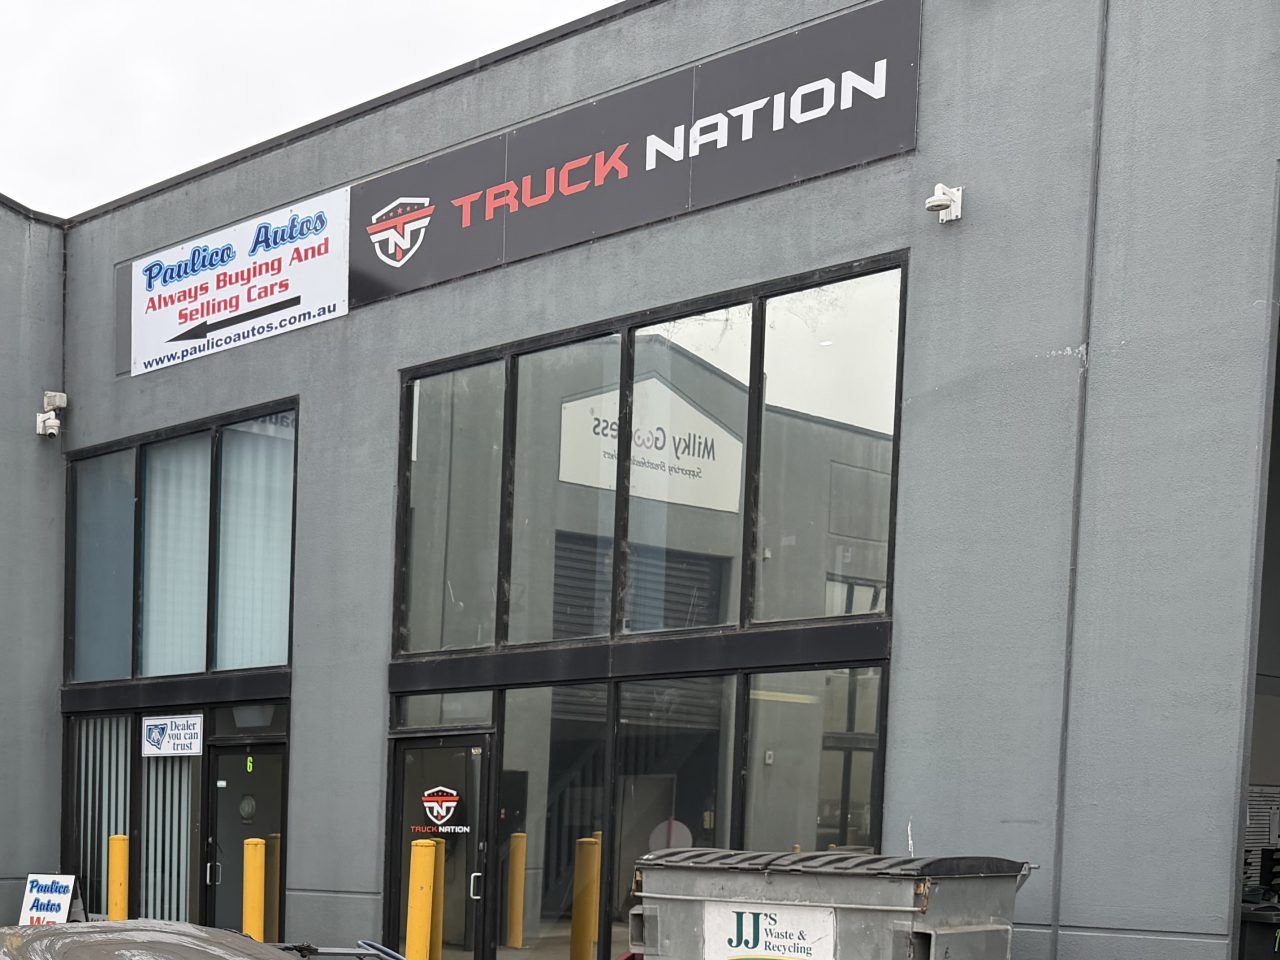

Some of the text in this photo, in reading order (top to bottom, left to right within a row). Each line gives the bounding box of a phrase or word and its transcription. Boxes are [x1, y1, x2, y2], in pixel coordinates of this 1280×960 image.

[451, 58, 887, 229] TRUCK NATION
[142, 211, 327, 292] Paulico Autos
[145, 237, 330, 314] Always Buying And
[178, 278, 290, 326] Selling Cars
[143, 303, 337, 370] www.paulicoautos.com.au
[170, 720, 197, 732] Dealer
[168, 731, 199, 742] you can
[173, 741, 193, 751] trust
[246, 756, 254, 774] 6
[410, 825, 470, 833] TRUCK NATION
[29, 878, 71, 895] Paulico
[29, 897, 62, 913] Autos
[764, 928, 807, 941] Waste &
[764, 941, 813, 957] Recycling
